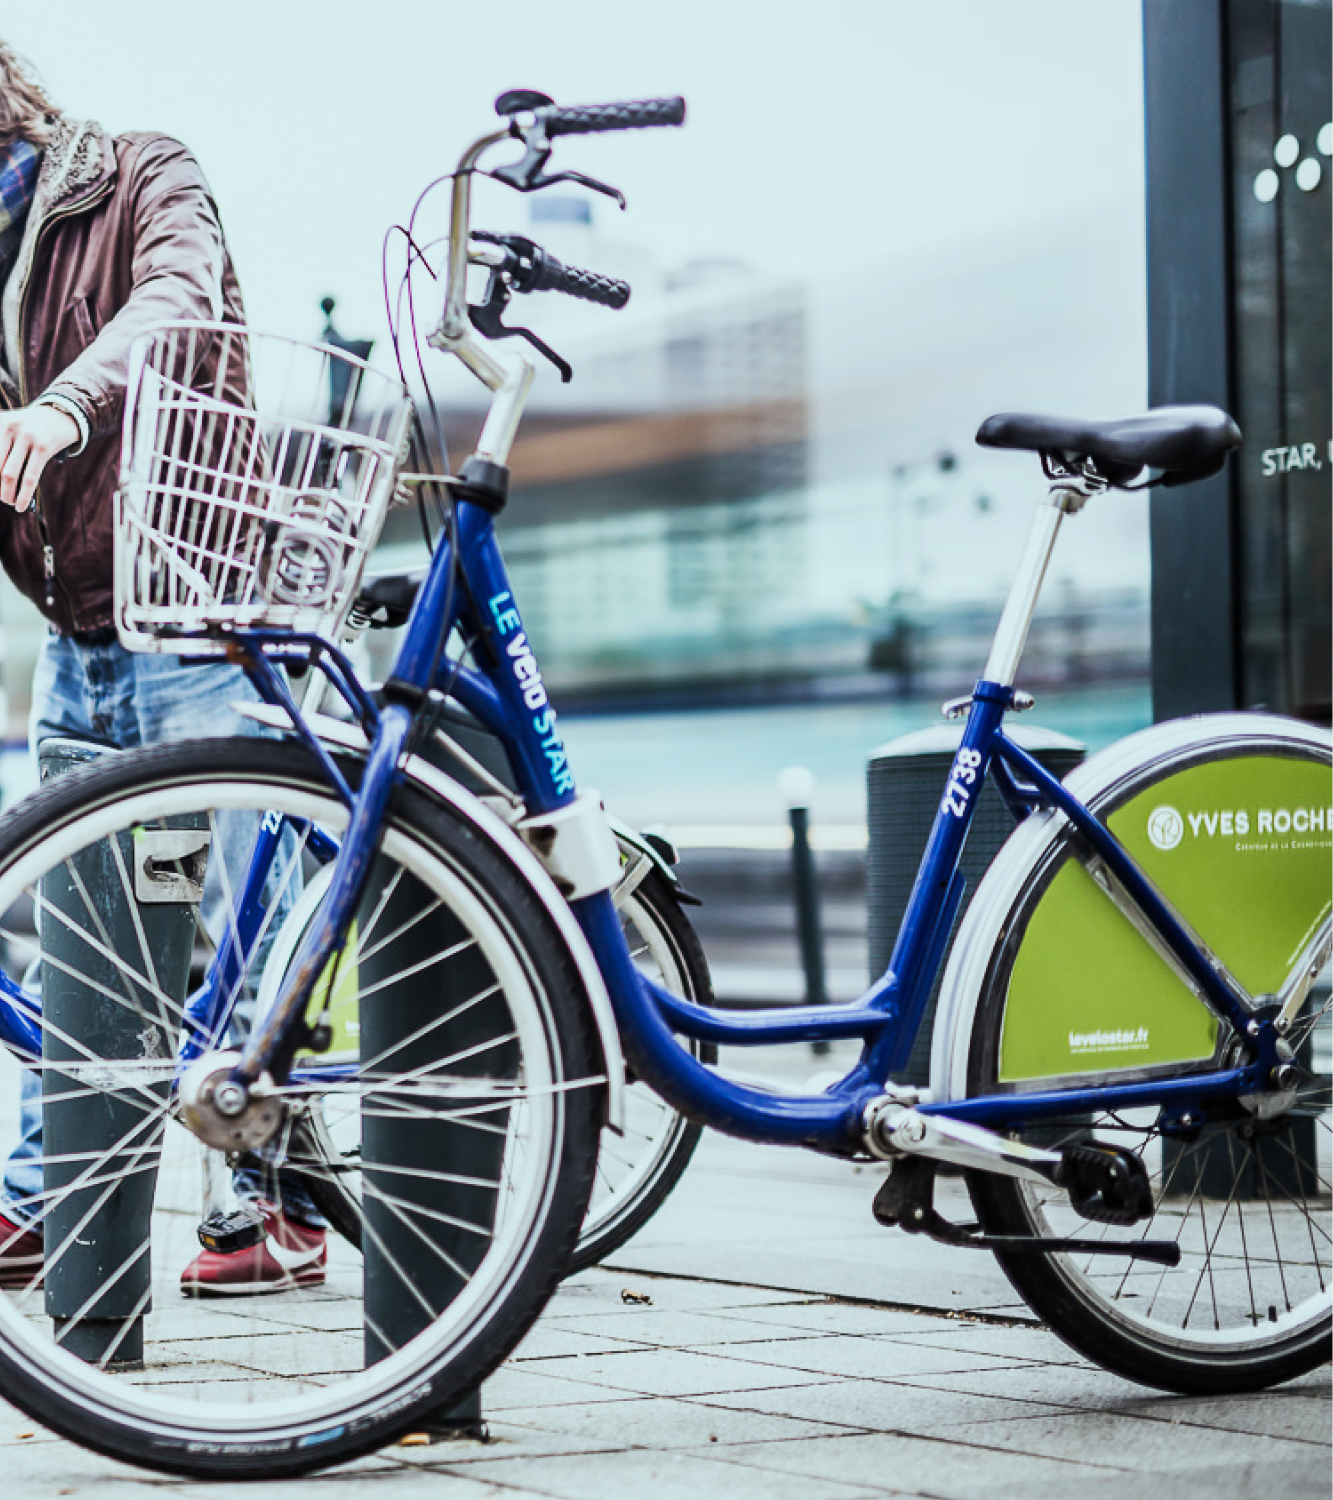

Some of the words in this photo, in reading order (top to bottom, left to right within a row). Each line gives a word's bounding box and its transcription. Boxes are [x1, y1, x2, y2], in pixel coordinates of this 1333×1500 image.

[1261, 442, 1322, 476] STAR,
[488, 590, 520, 635] LE
[532, 708, 575, 796] STAR
[940, 747, 982, 818] 2738
[1187, 810, 1249, 837] YVES
[1069, 1026, 1149, 1047] levelostar.fr
